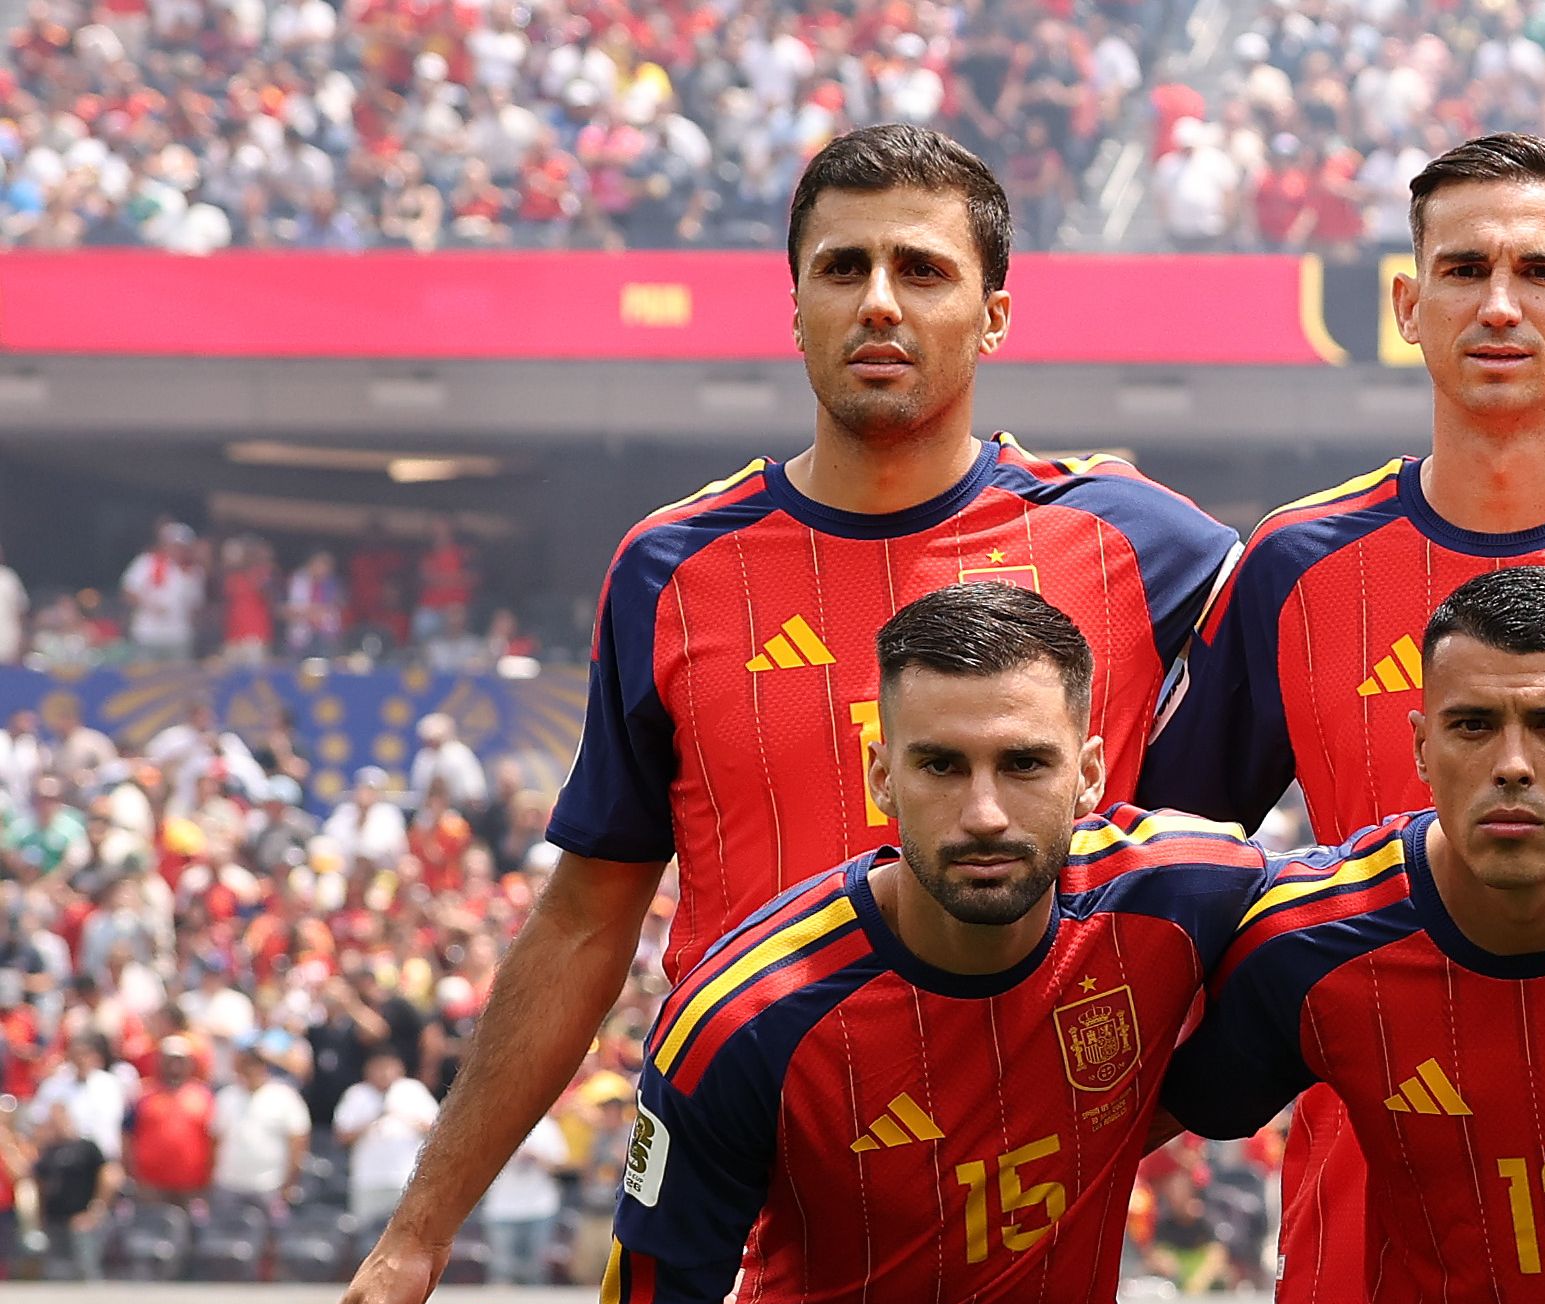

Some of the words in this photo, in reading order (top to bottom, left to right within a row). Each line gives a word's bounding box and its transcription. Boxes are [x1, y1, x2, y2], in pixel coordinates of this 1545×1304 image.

[850, 700, 889, 827] 1
[625, 1178, 642, 1193] 26
[955, 1133, 1067, 1264] 15
